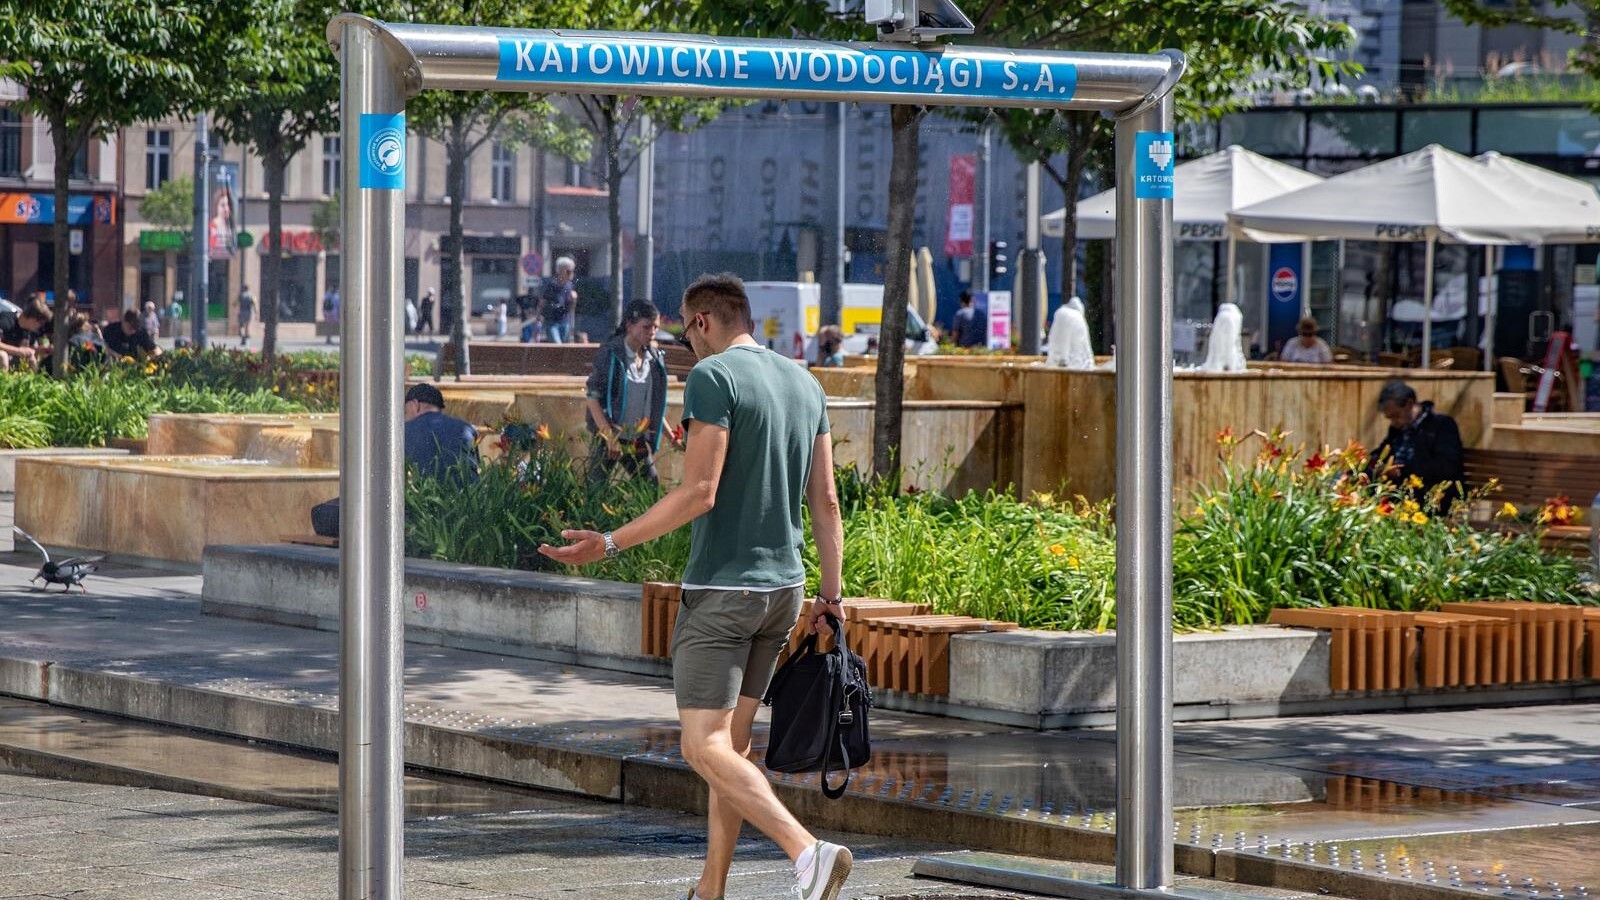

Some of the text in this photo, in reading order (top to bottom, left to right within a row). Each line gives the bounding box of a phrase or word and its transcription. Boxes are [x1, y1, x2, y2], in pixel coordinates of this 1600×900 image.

[514, 39, 1066, 94] KATOWICKIE WODOCIĄGI S.A.
[15, 201, 41, 218] STS
[1180, 222, 1223, 238] PEPSI
[1376, 223, 1427, 238] PEPSI
